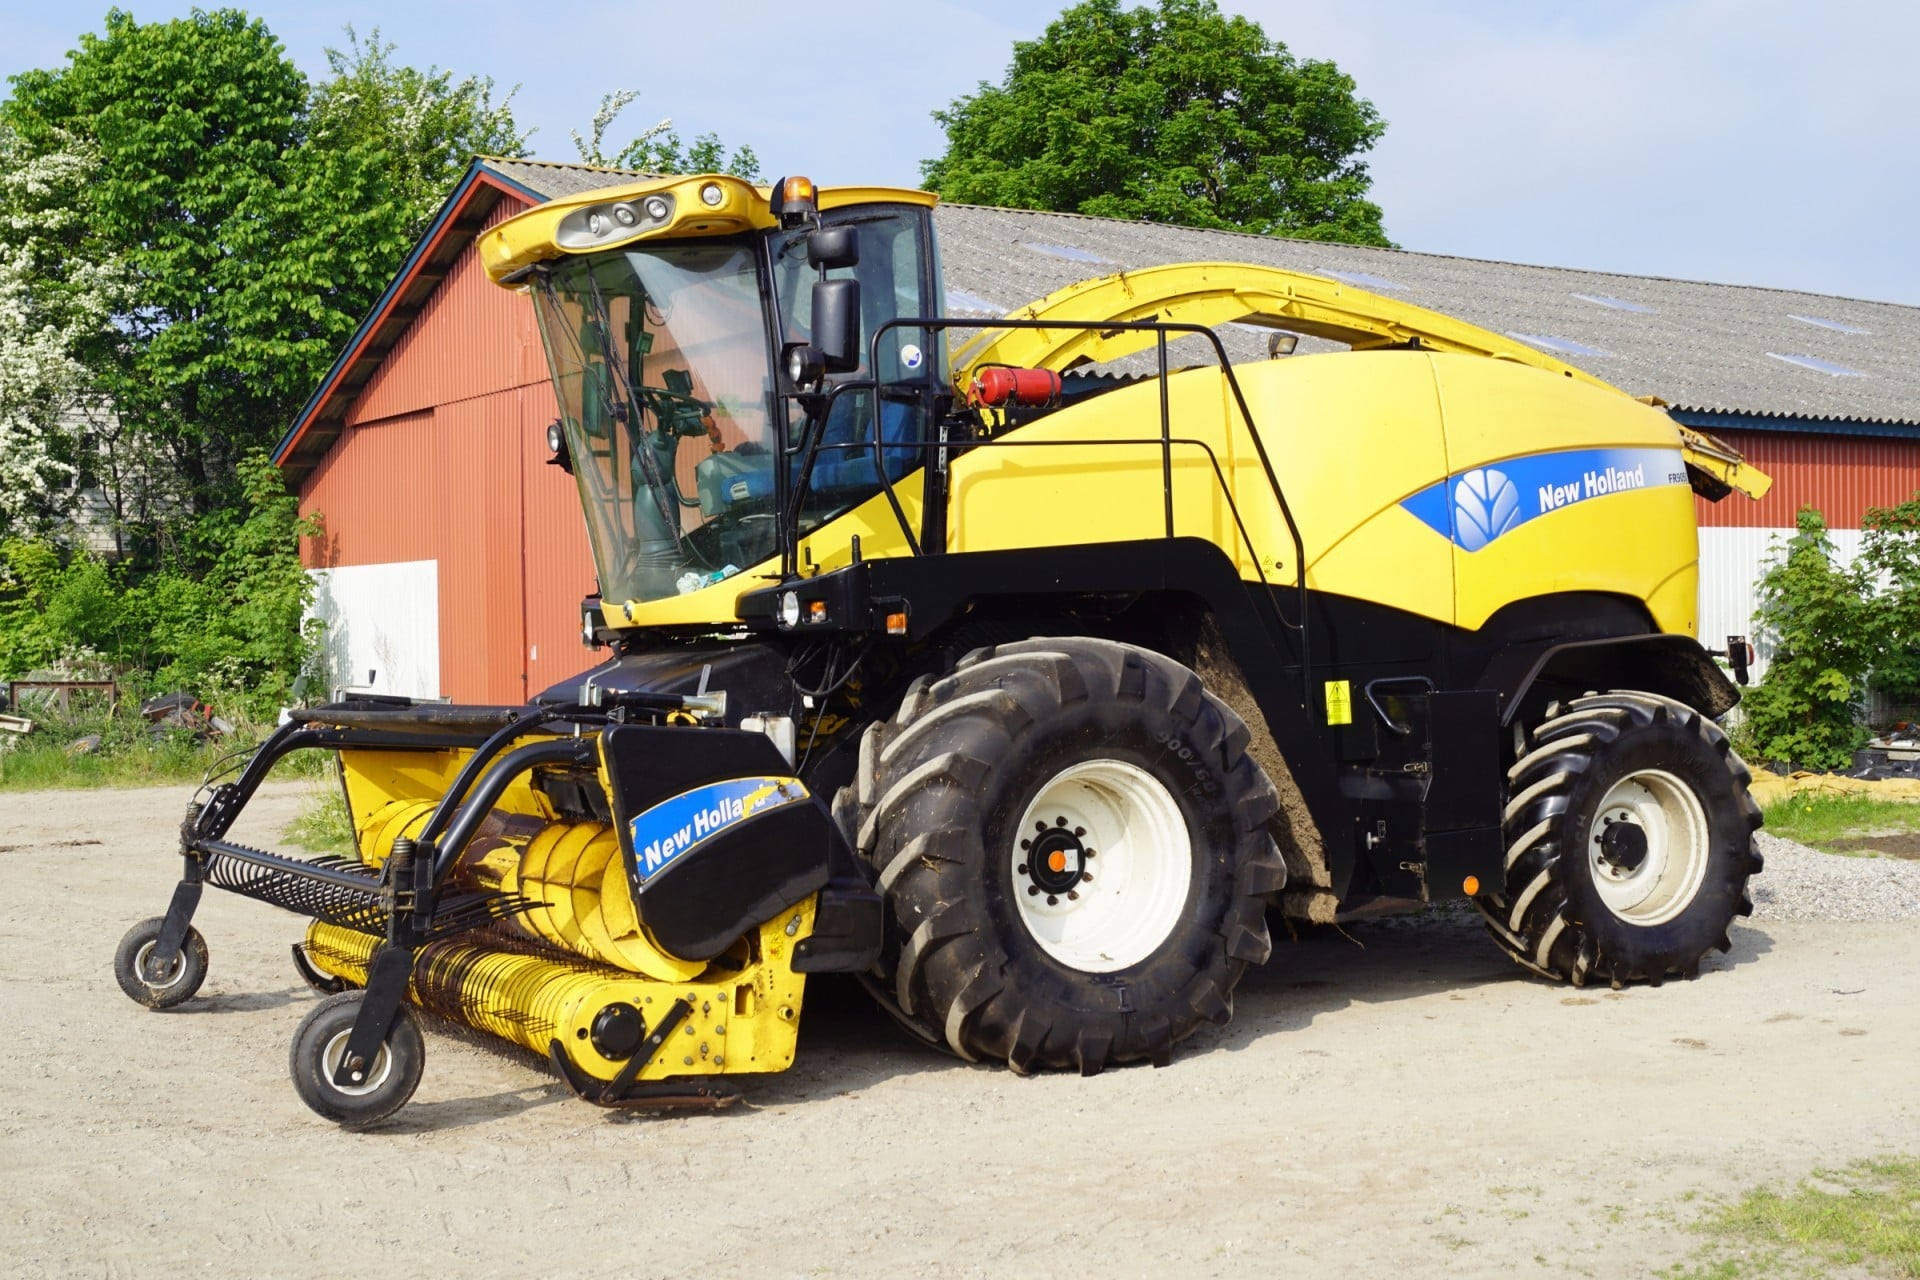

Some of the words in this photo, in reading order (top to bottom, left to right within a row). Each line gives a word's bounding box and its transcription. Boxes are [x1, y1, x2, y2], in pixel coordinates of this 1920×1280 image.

[1538, 480, 1580, 513] New
[1583, 464, 1644, 498] Holland
[644, 822, 691, 872] New
[693, 783, 767, 837] Hollad
